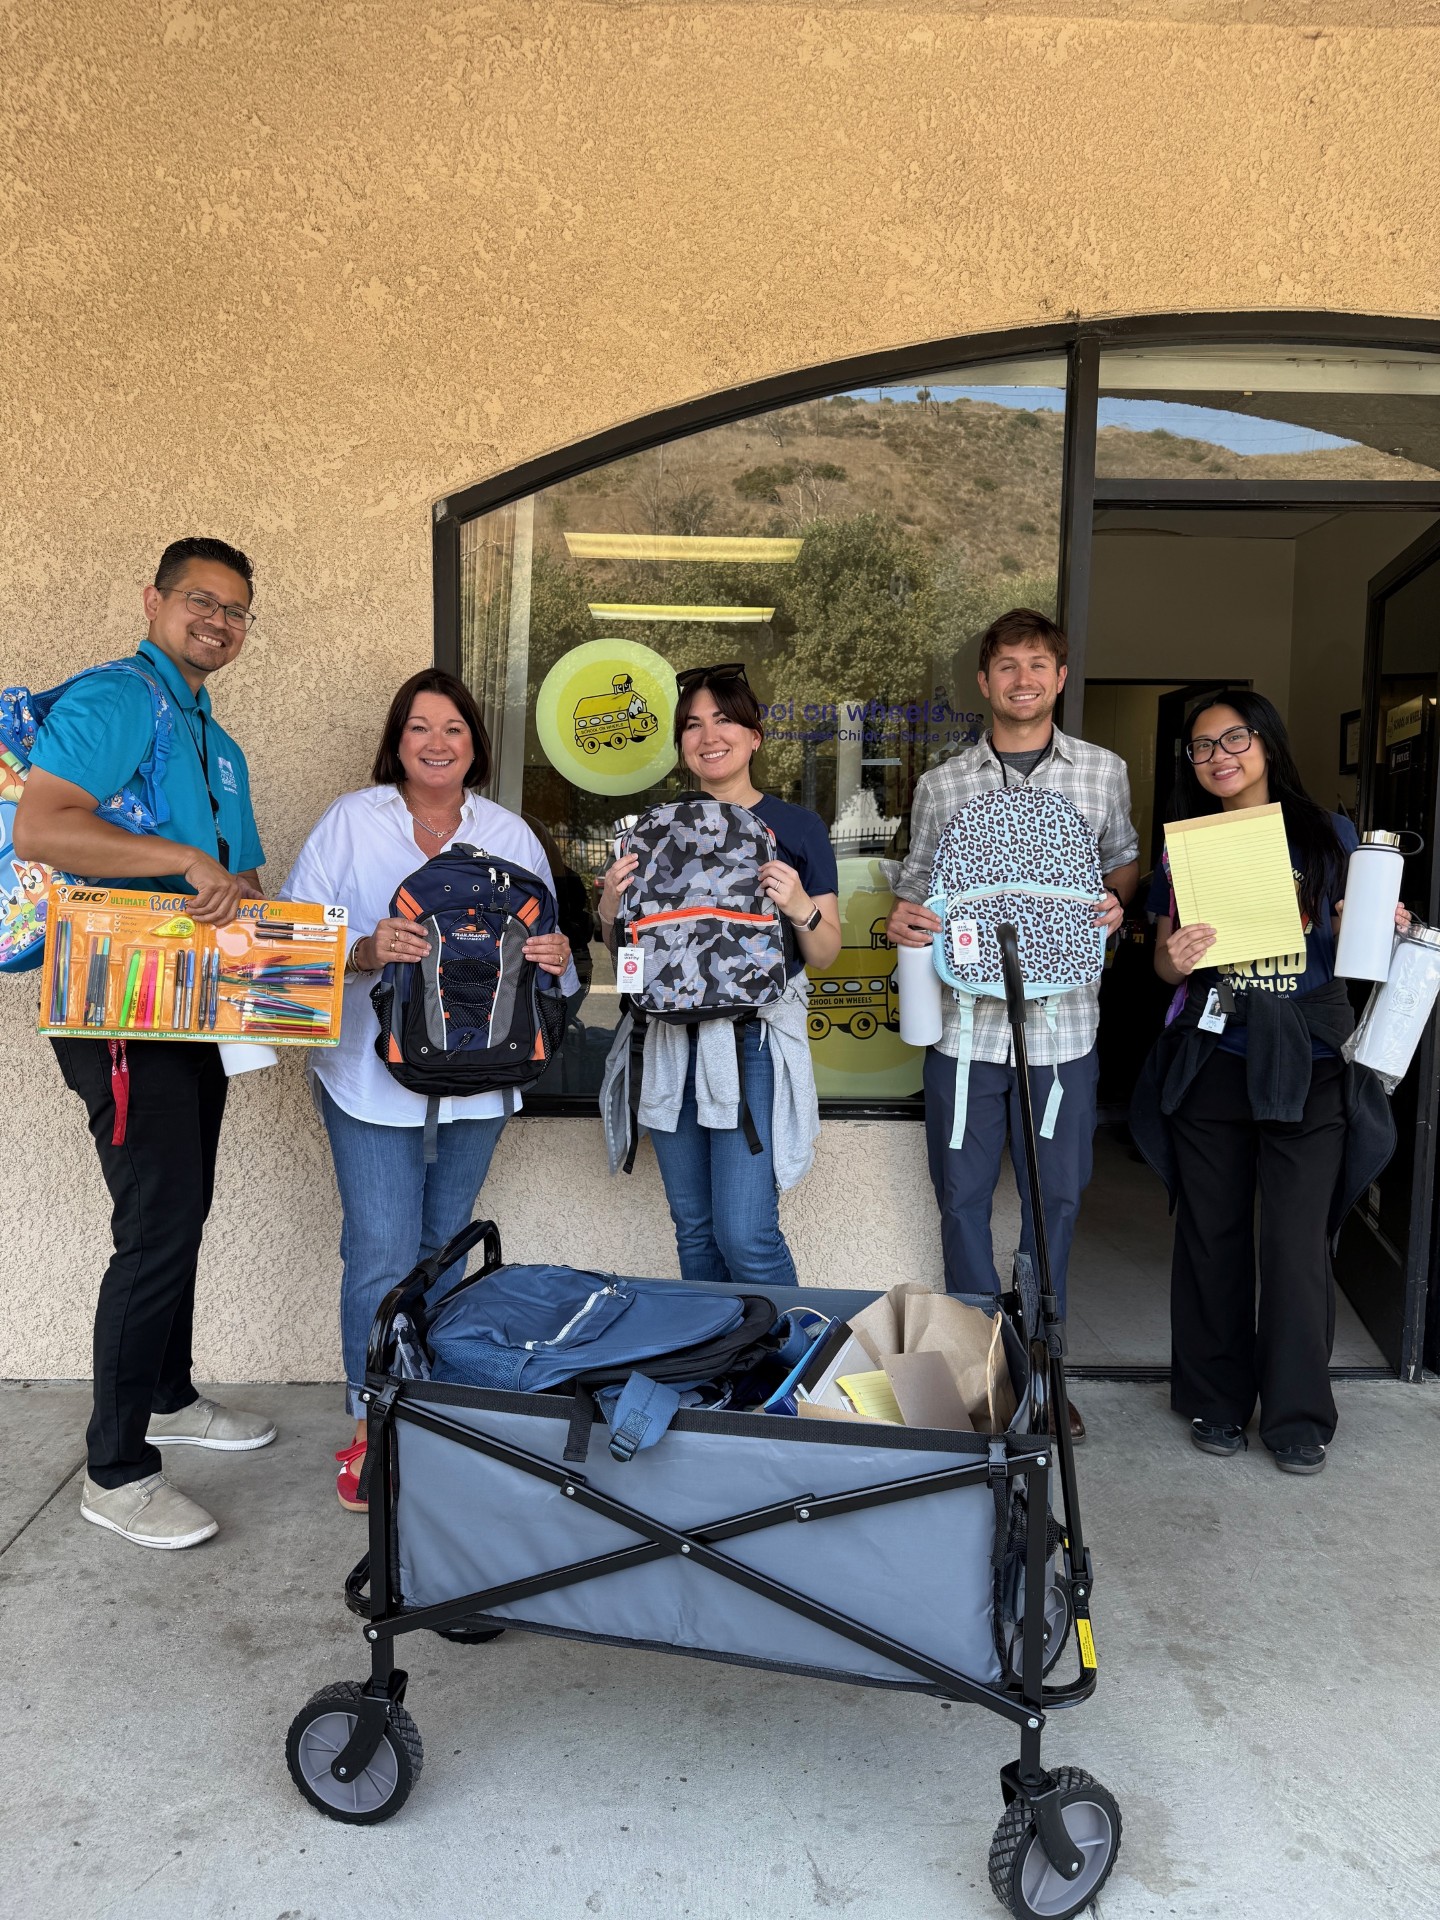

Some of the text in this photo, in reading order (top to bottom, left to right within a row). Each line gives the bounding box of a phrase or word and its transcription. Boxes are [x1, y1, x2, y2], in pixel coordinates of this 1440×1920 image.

[757, 697, 794, 722] ool
[803, 703, 838, 722] on
[846, 699, 946, 723] wheels
[838, 729, 896, 741] Children
[901, 730, 940, 742] Since
[110, 896, 147, 907] ULTIMATE
[236, 902, 283, 920] ool KIT
[327, 907, 345, 919] 42
[1276, 976, 1298, 993] US
[833, 997, 844, 1005] ON
[846, 996, 872, 1004] WHEELS
